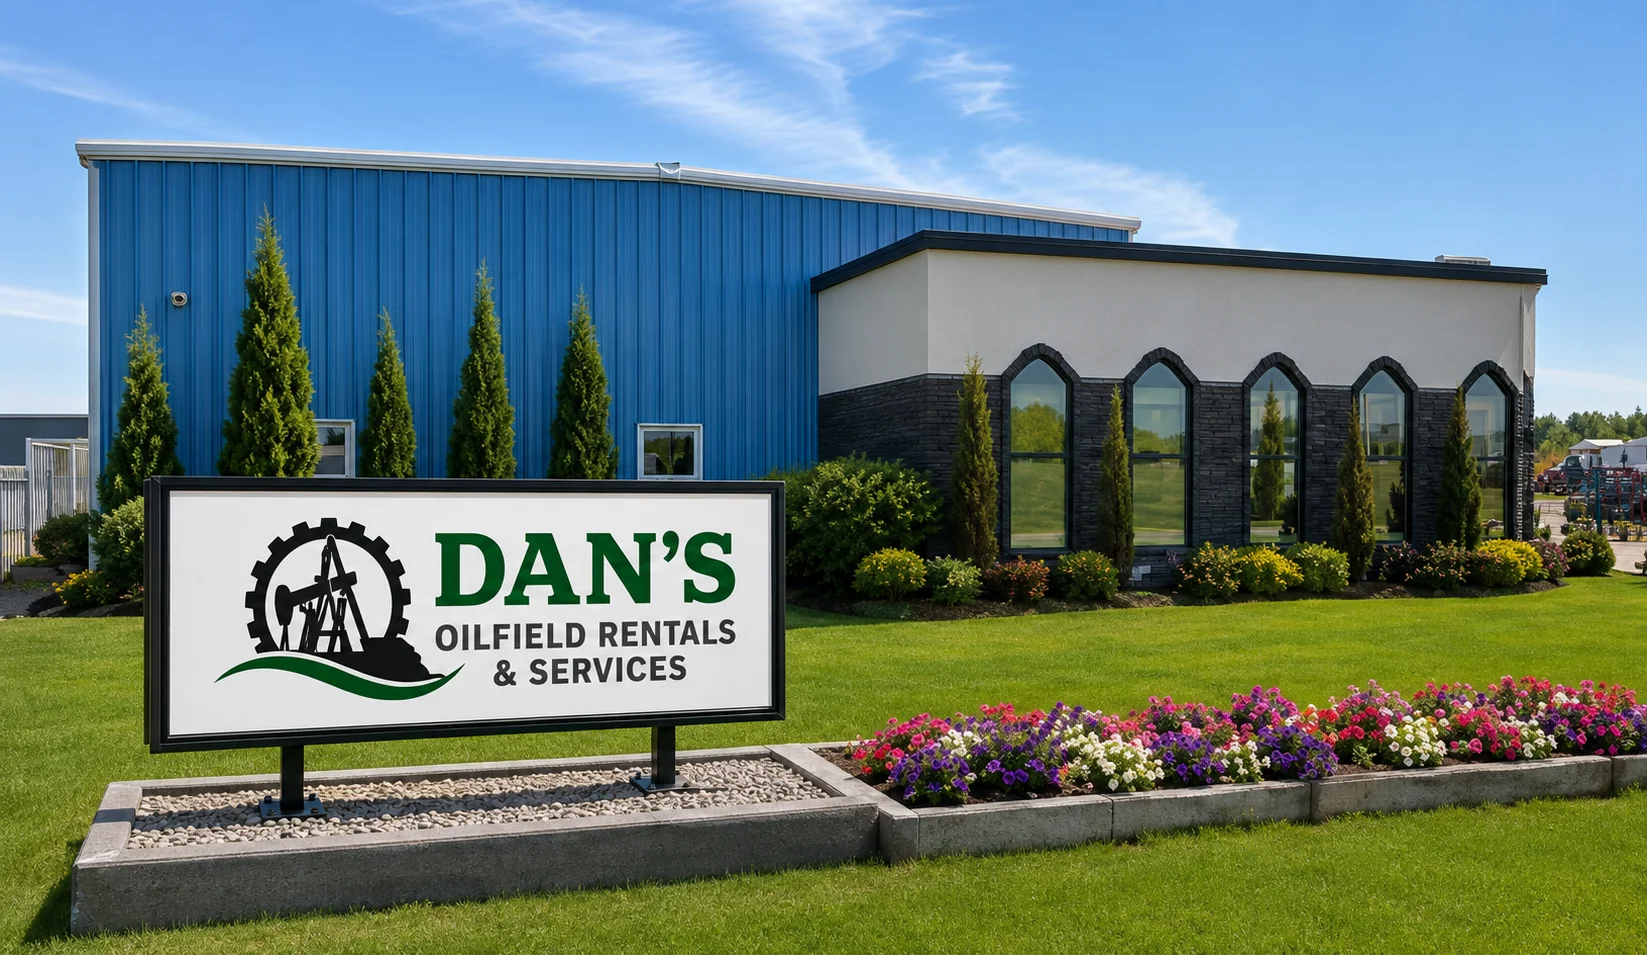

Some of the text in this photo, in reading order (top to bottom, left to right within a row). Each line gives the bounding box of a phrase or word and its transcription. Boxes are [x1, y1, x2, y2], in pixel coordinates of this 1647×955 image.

[434, 530, 737, 607] DAN'S
[435, 618, 737, 652] OILFIELD RENTALS
[493, 655, 687, 687] & SERVICES
